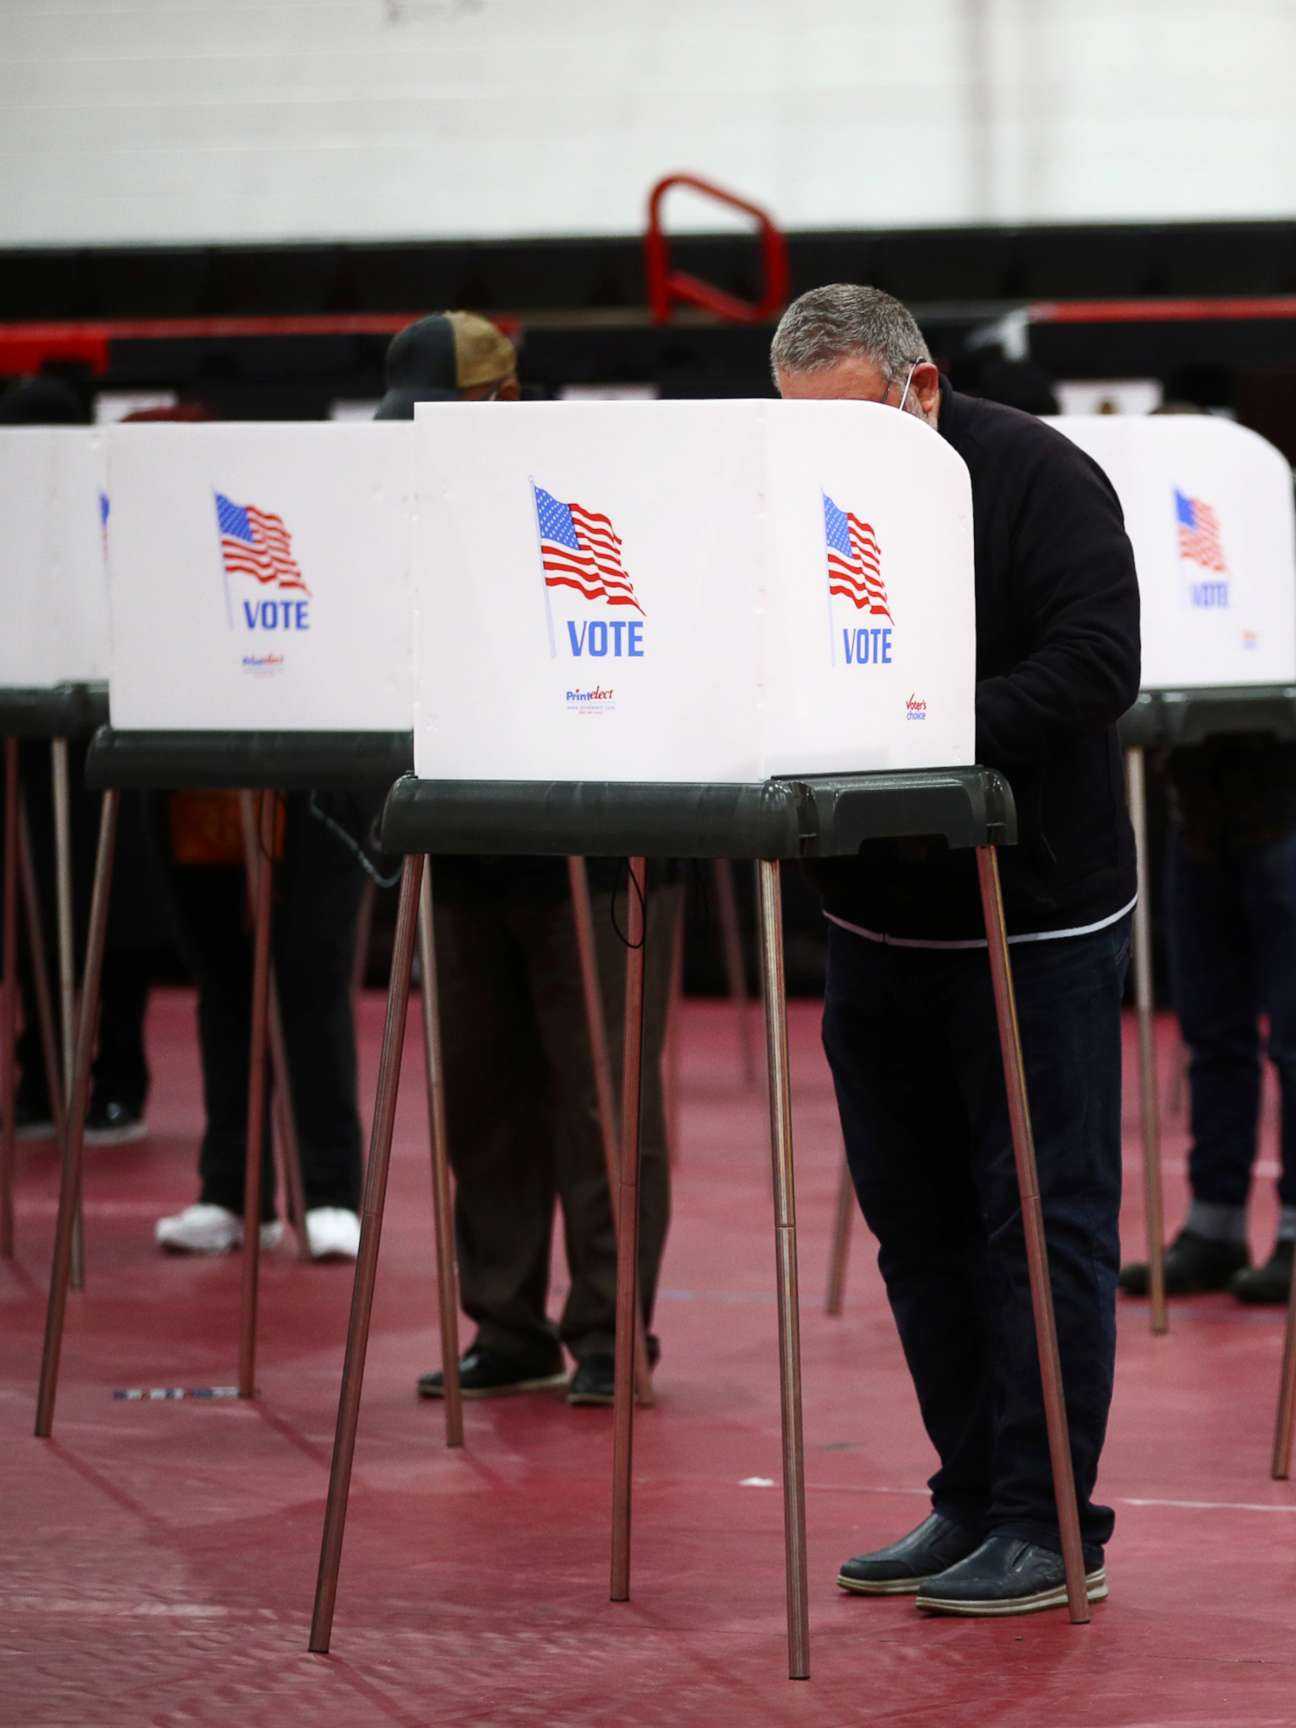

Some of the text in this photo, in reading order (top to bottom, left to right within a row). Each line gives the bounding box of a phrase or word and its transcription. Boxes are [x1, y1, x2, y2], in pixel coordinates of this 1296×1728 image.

[243, 599, 310, 631] VOTE
[566, 620, 645, 657] VOTE
[843, 628, 893, 664] VOTE
[906, 711, 926, 720] choice
